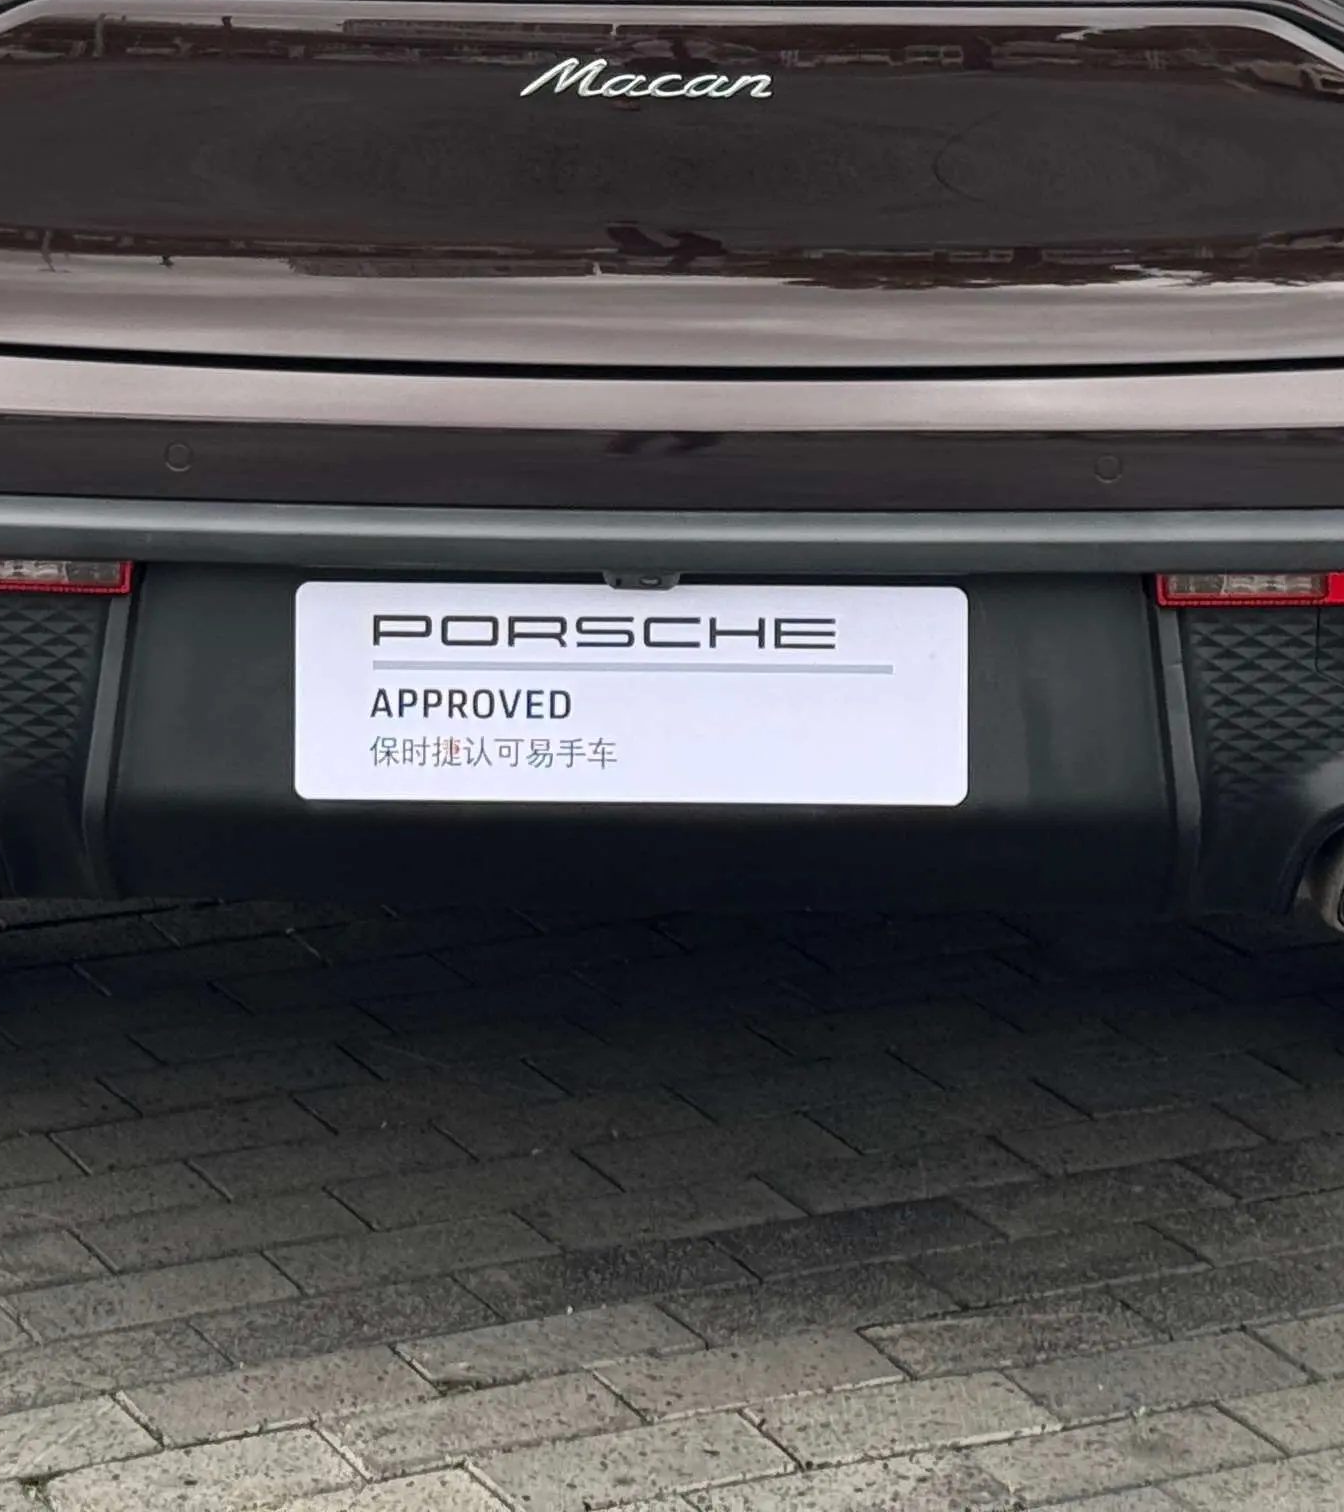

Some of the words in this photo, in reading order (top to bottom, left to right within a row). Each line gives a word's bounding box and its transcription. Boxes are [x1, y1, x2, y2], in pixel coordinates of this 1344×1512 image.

[520, 57, 774, 99] Macan
[372, 614, 836, 650] PORSCHE
[370, 688, 572, 720] APPROVED
[370, 735, 618, 769] 保时捷认可易手车
